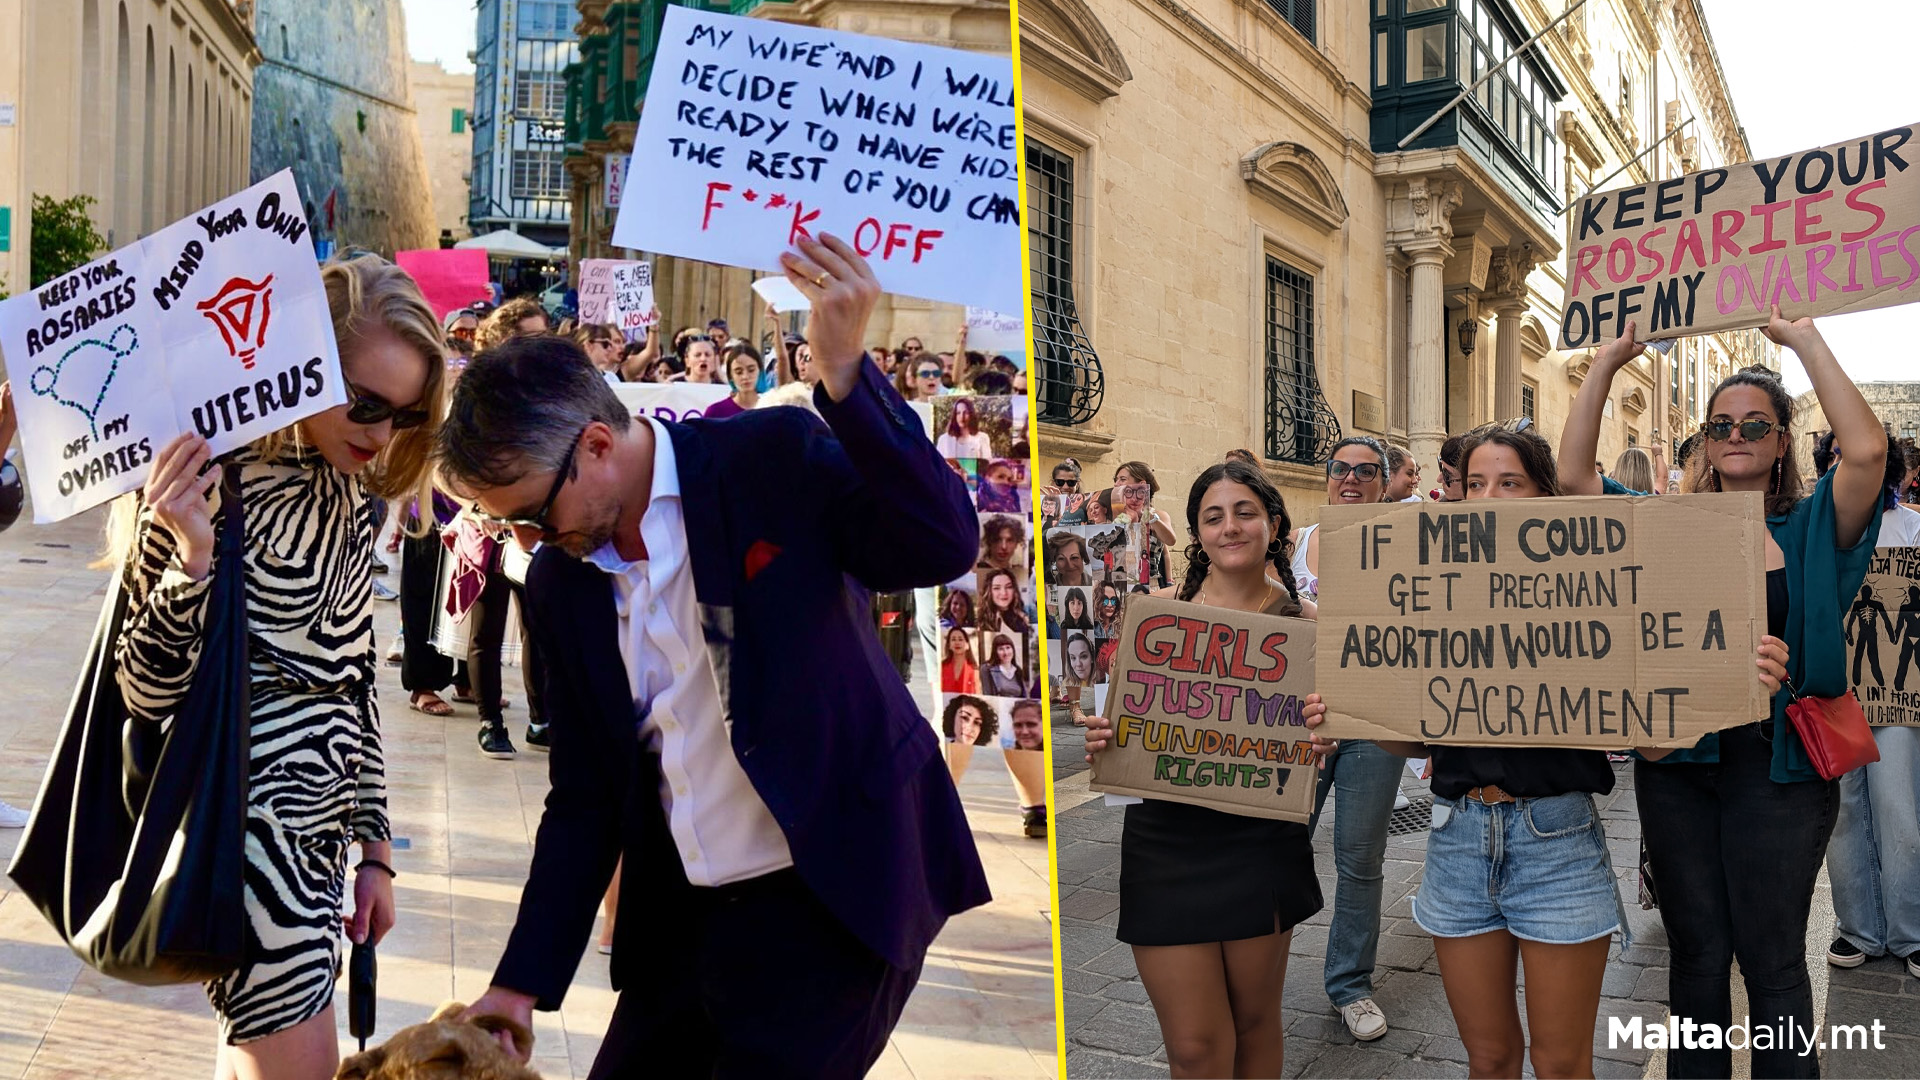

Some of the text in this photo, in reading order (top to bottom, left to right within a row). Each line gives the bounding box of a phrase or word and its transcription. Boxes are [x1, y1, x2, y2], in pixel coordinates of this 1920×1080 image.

[686, 24, 733, 48] MY
[838, 54, 896, 81] AND
[911, 61, 923, 90] I
[682, 60, 799, 109] DECIDE
[820, 87, 916, 127] WHEN
[677, 100, 789, 144] READY
[804, 121, 839, 152] TO
[858, 134, 944, 169] HAVE
[609, 163, 619, 204] KING
[668, 137, 725, 168] THE
[747, 150, 828, 182] REST
[844, 169, 883, 193] OF
[896, 176, 951, 212] YOU
[967, 192, 1020, 226] CAN
[1580, 127, 1914, 241] KEEP YOUR
[153, 192, 306, 310] MIND YOUR OWN
[854, 217, 944, 264] OFF
[1572, 179, 1887, 297] ROSARIES
[39, 259, 123, 310] KEEP YOUR
[635, 291, 643, 301] V
[1563, 224, 1920, 348] OFF MY OVARIES
[27, 277, 136, 357] ROSARIES
[624, 312, 652, 327] NOW
[192, 357, 324, 440] UTERUS
[62, 414, 130, 460] OFF MY
[58, 438, 152, 497] OVARIES
[1361, 511, 1626, 570] IF MEN COULD
[1389, 565, 1643, 616] GET PREGNANT
[1134, 614, 1288, 682] GIRLS
[1341, 609, 1726, 669] ABORTION WOULD BE A
[1124, 670, 1242, 721] JUST
[1420, 676, 1690, 739] SACRAMENT
[1867, 686, 1887, 701] INT
[1154, 755, 1292, 796] RIGHTS!
